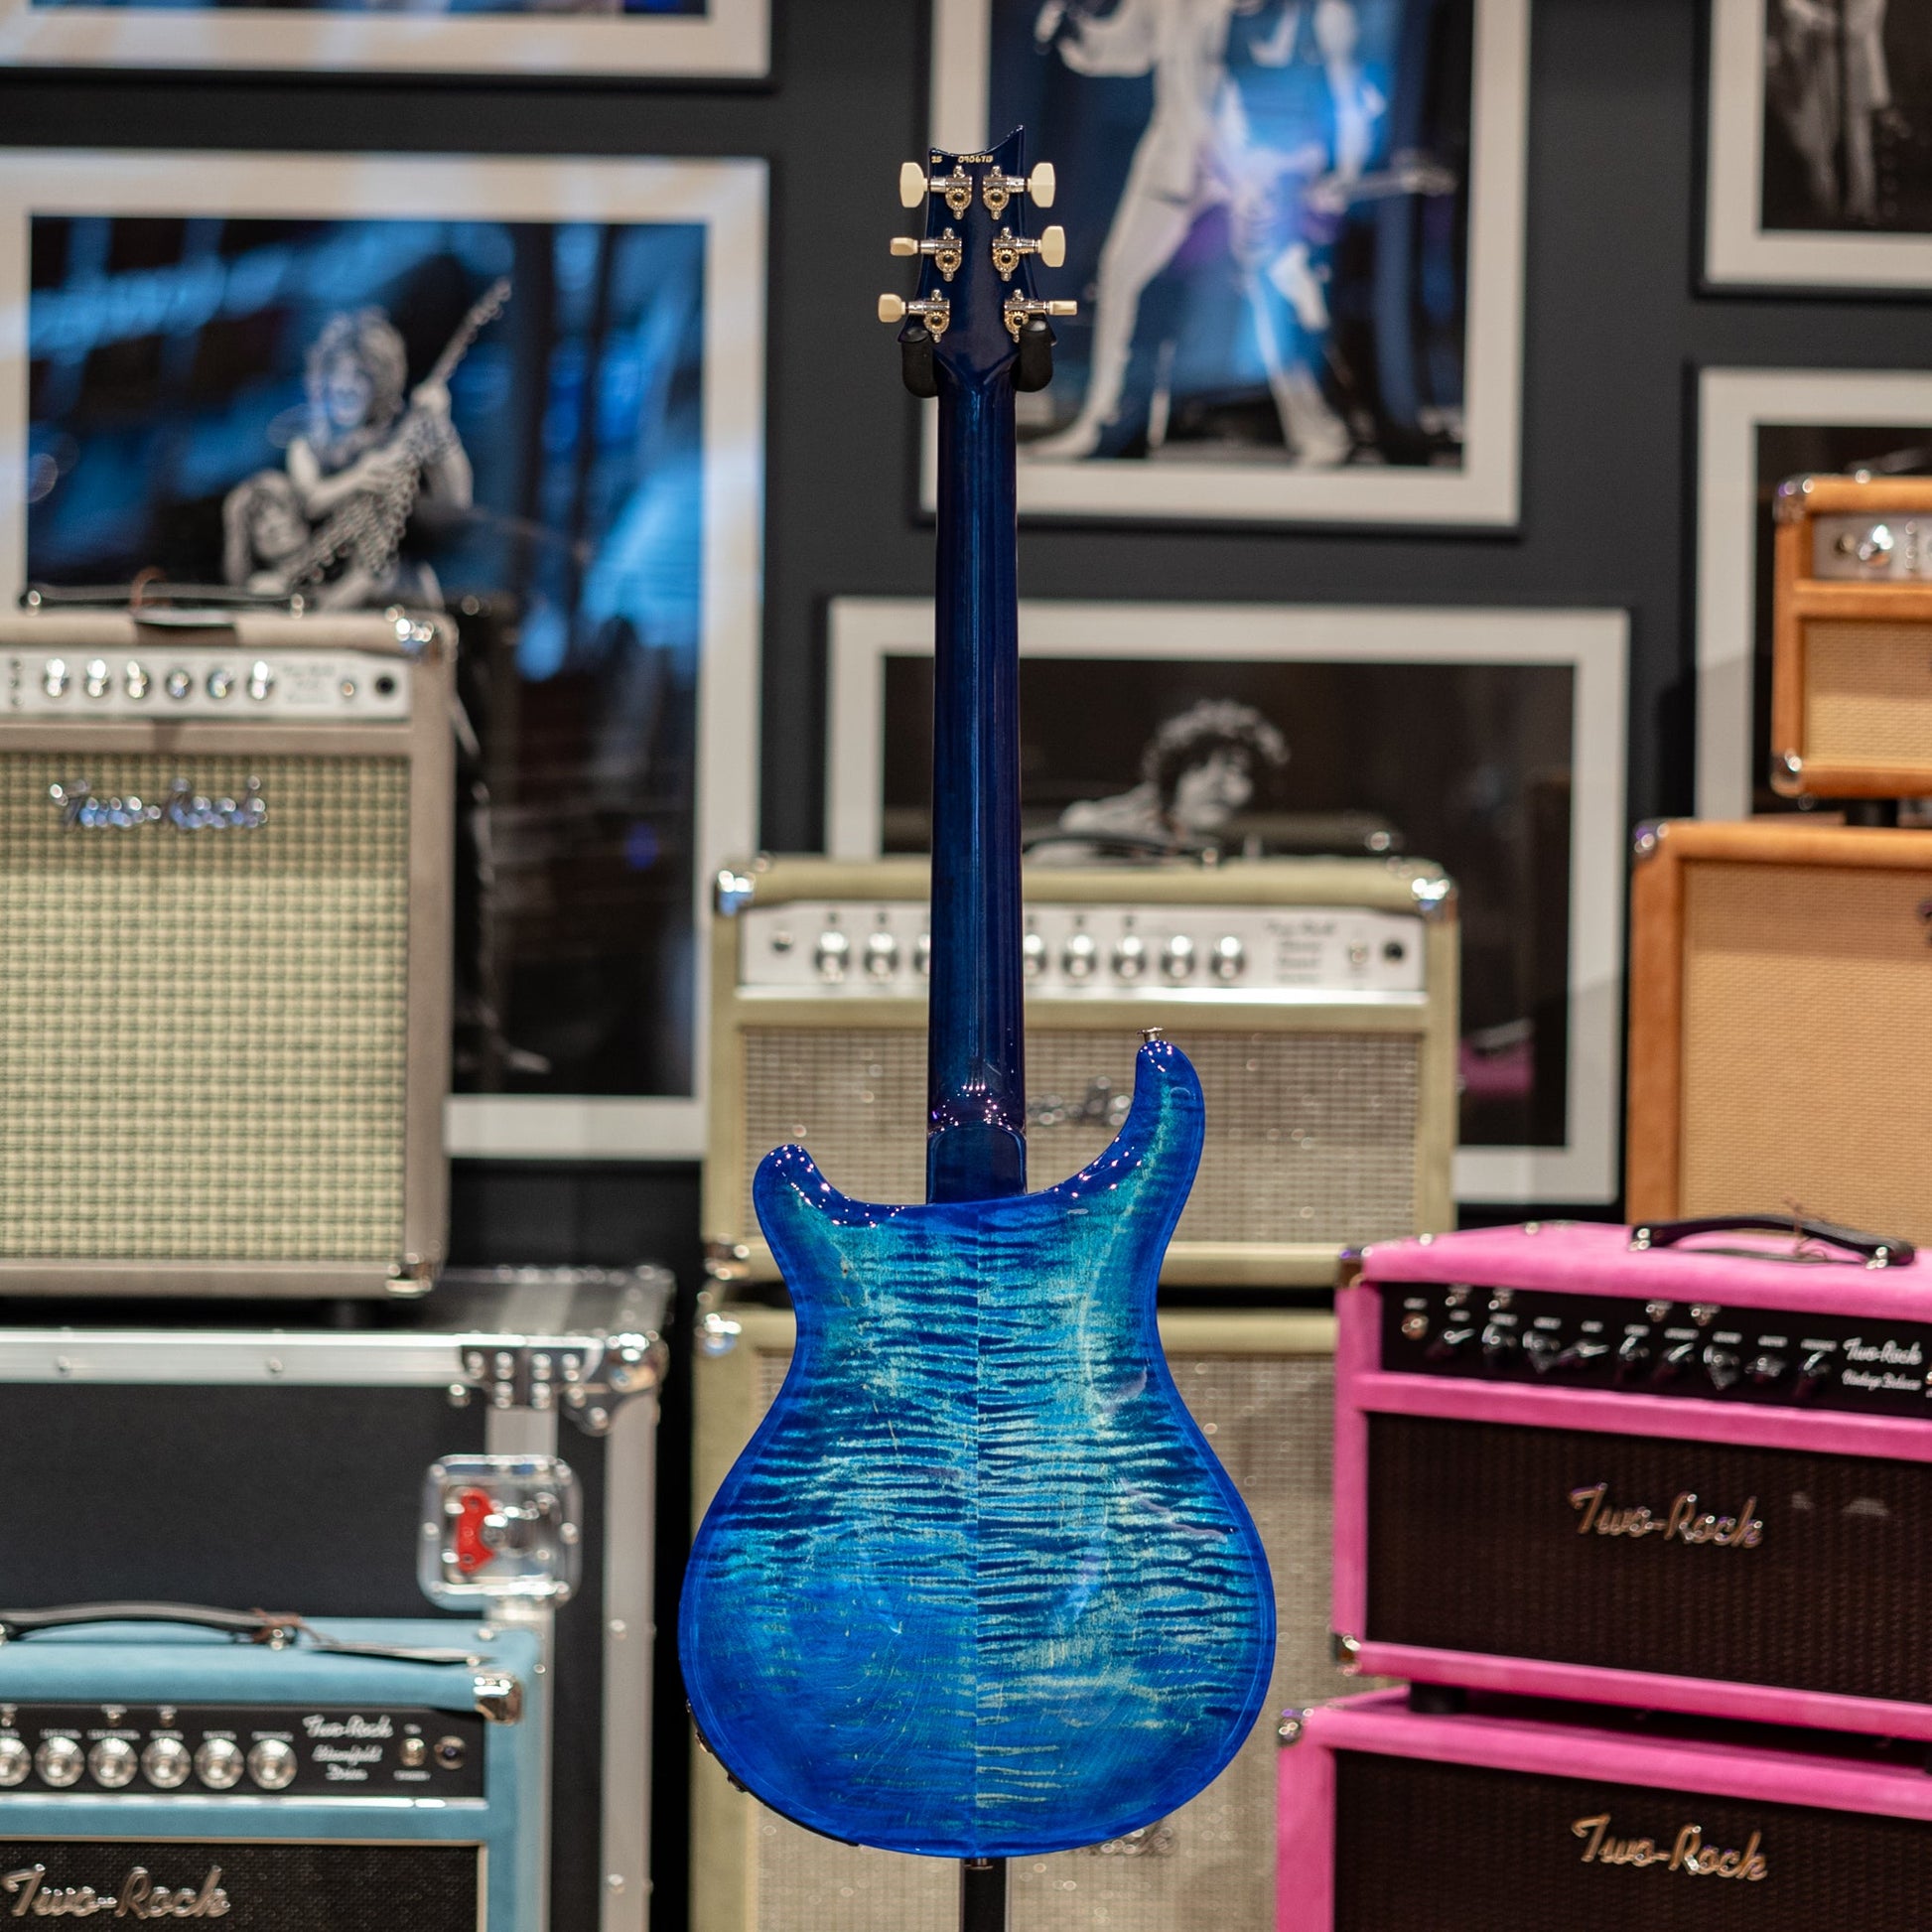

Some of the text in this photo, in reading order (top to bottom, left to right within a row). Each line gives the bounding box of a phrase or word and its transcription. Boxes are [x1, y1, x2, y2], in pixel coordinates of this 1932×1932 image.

[1843, 1337, 1922, 1365] Two-Rock
[1569, 1482, 1762, 1549] Two-Rock
[1571, 1813, 1768, 1881] Two-Rock
[3, 1863, 231, 1920] Two-Rock
